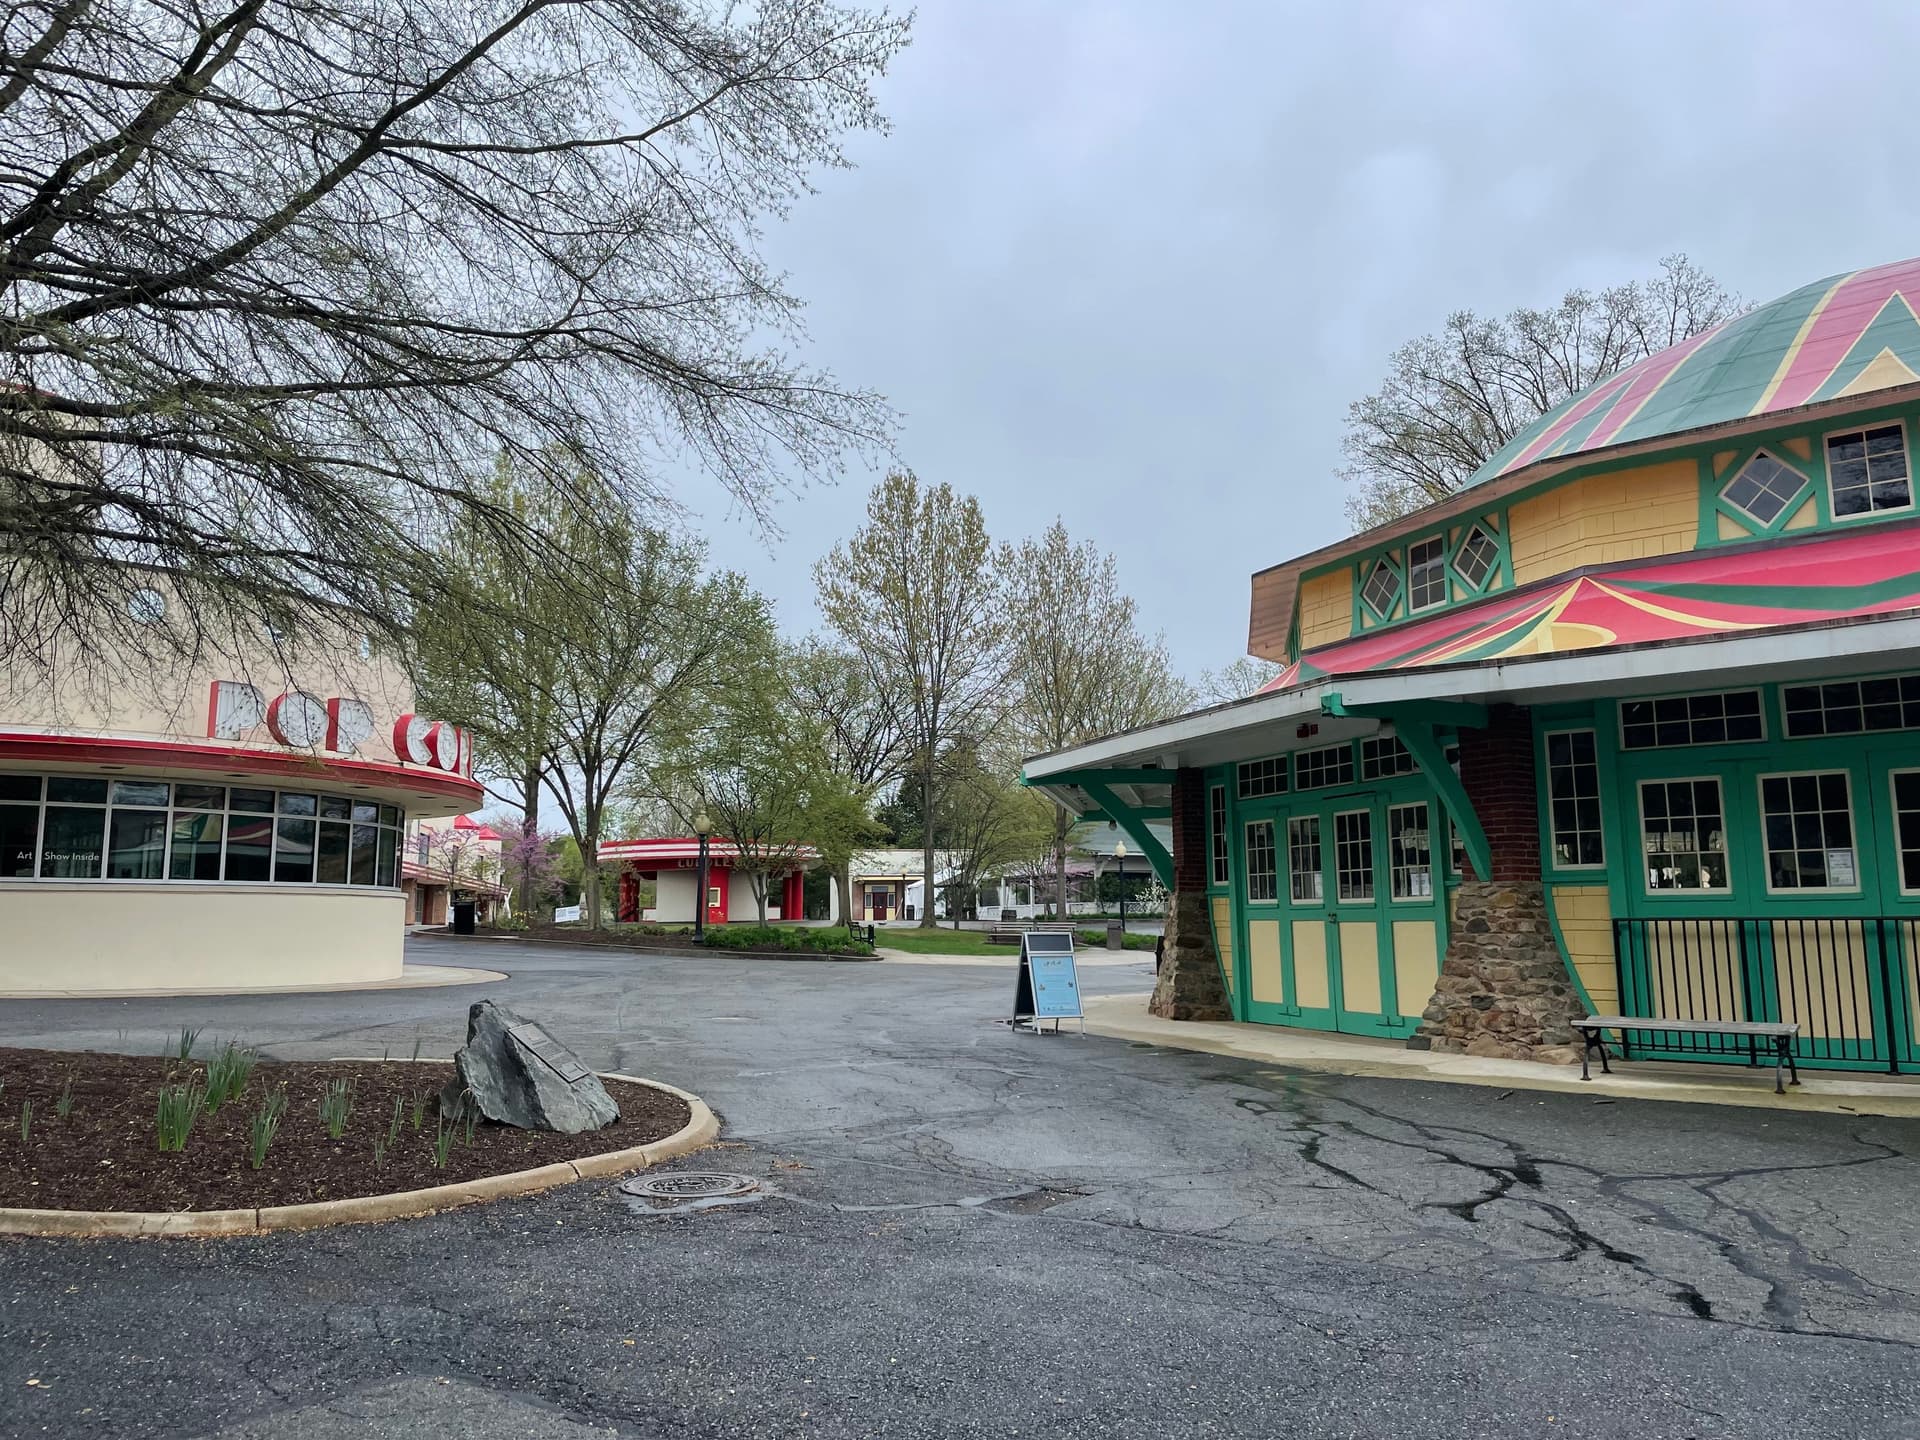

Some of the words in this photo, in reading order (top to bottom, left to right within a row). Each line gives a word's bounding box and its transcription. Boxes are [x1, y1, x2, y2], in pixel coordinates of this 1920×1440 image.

[207, 680, 374, 754] POP
[393, 713, 473, 780] COR
[17, 851, 33, 860] Art
[44, 851, 70, 861] Show
[72, 851, 100, 861] Inside
